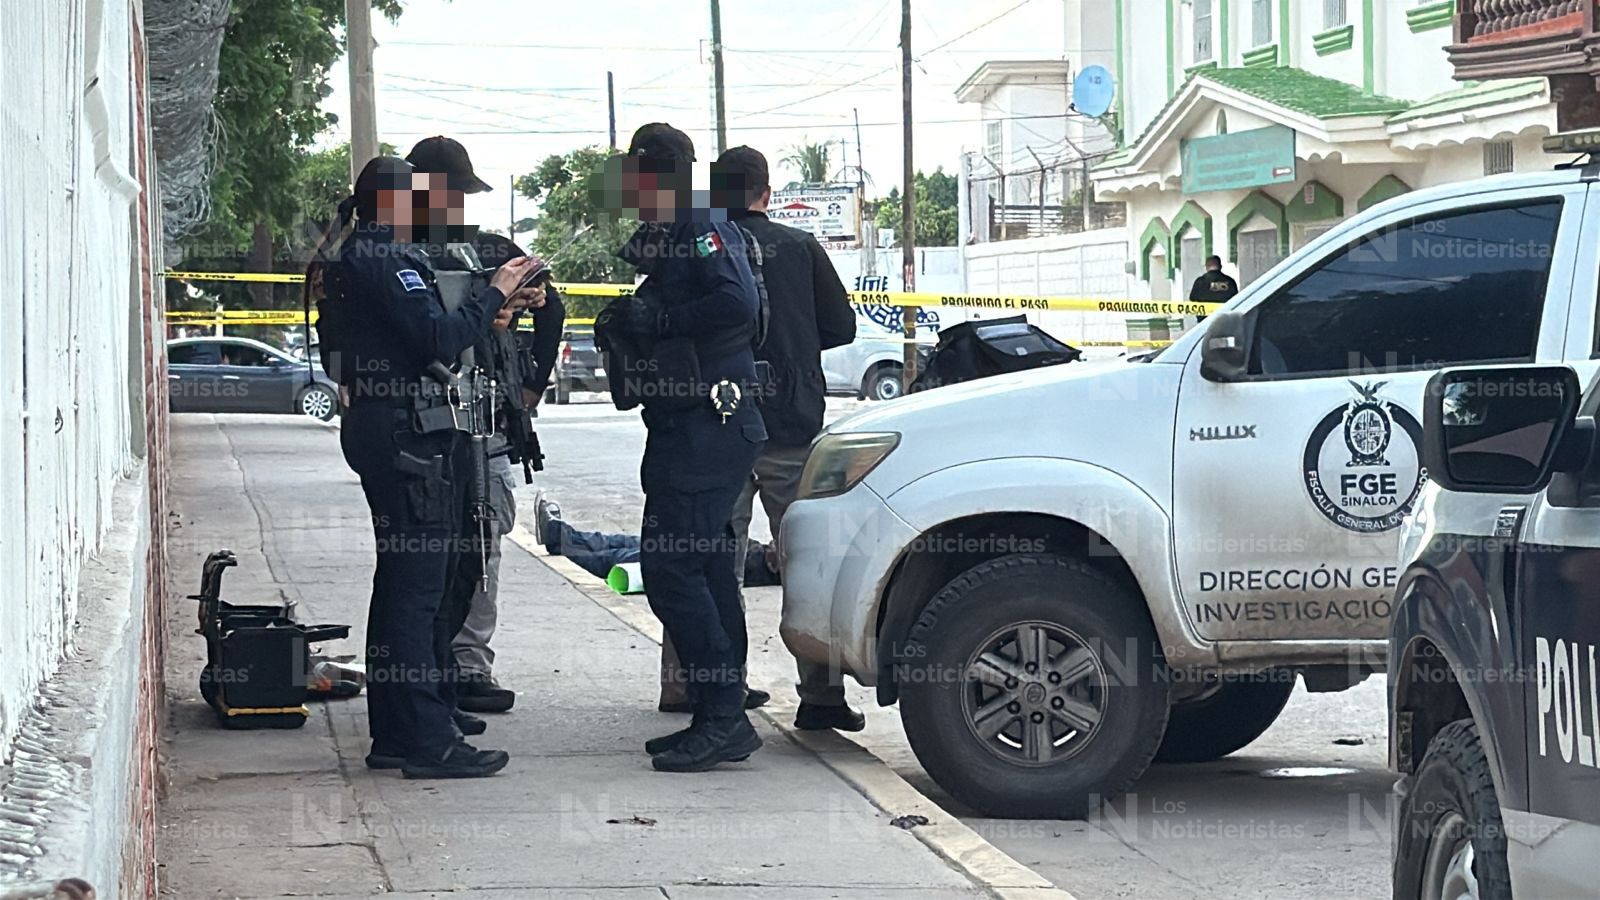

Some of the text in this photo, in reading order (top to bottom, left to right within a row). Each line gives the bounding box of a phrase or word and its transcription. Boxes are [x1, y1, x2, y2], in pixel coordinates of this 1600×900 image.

[861, 294, 890, 304] PASO
[941, 296, 1049, 310] PROHIBIDO EL PASO
[1098, 302, 1206, 317] PROHIBIDO EL PASO
[1190, 424, 1256, 441] HILUX
[1341, 473, 1397, 496] FGE
[1308, 470, 1336, 517] FISCALÍA
[1337, 513, 1388, 530] GENERAL
[1341, 496, 1398, 507] SINALOA
[1199, 563, 1352, 592] DIRECCIÓN
[1196, 594, 1391, 623] INVESTIGACIÓ
